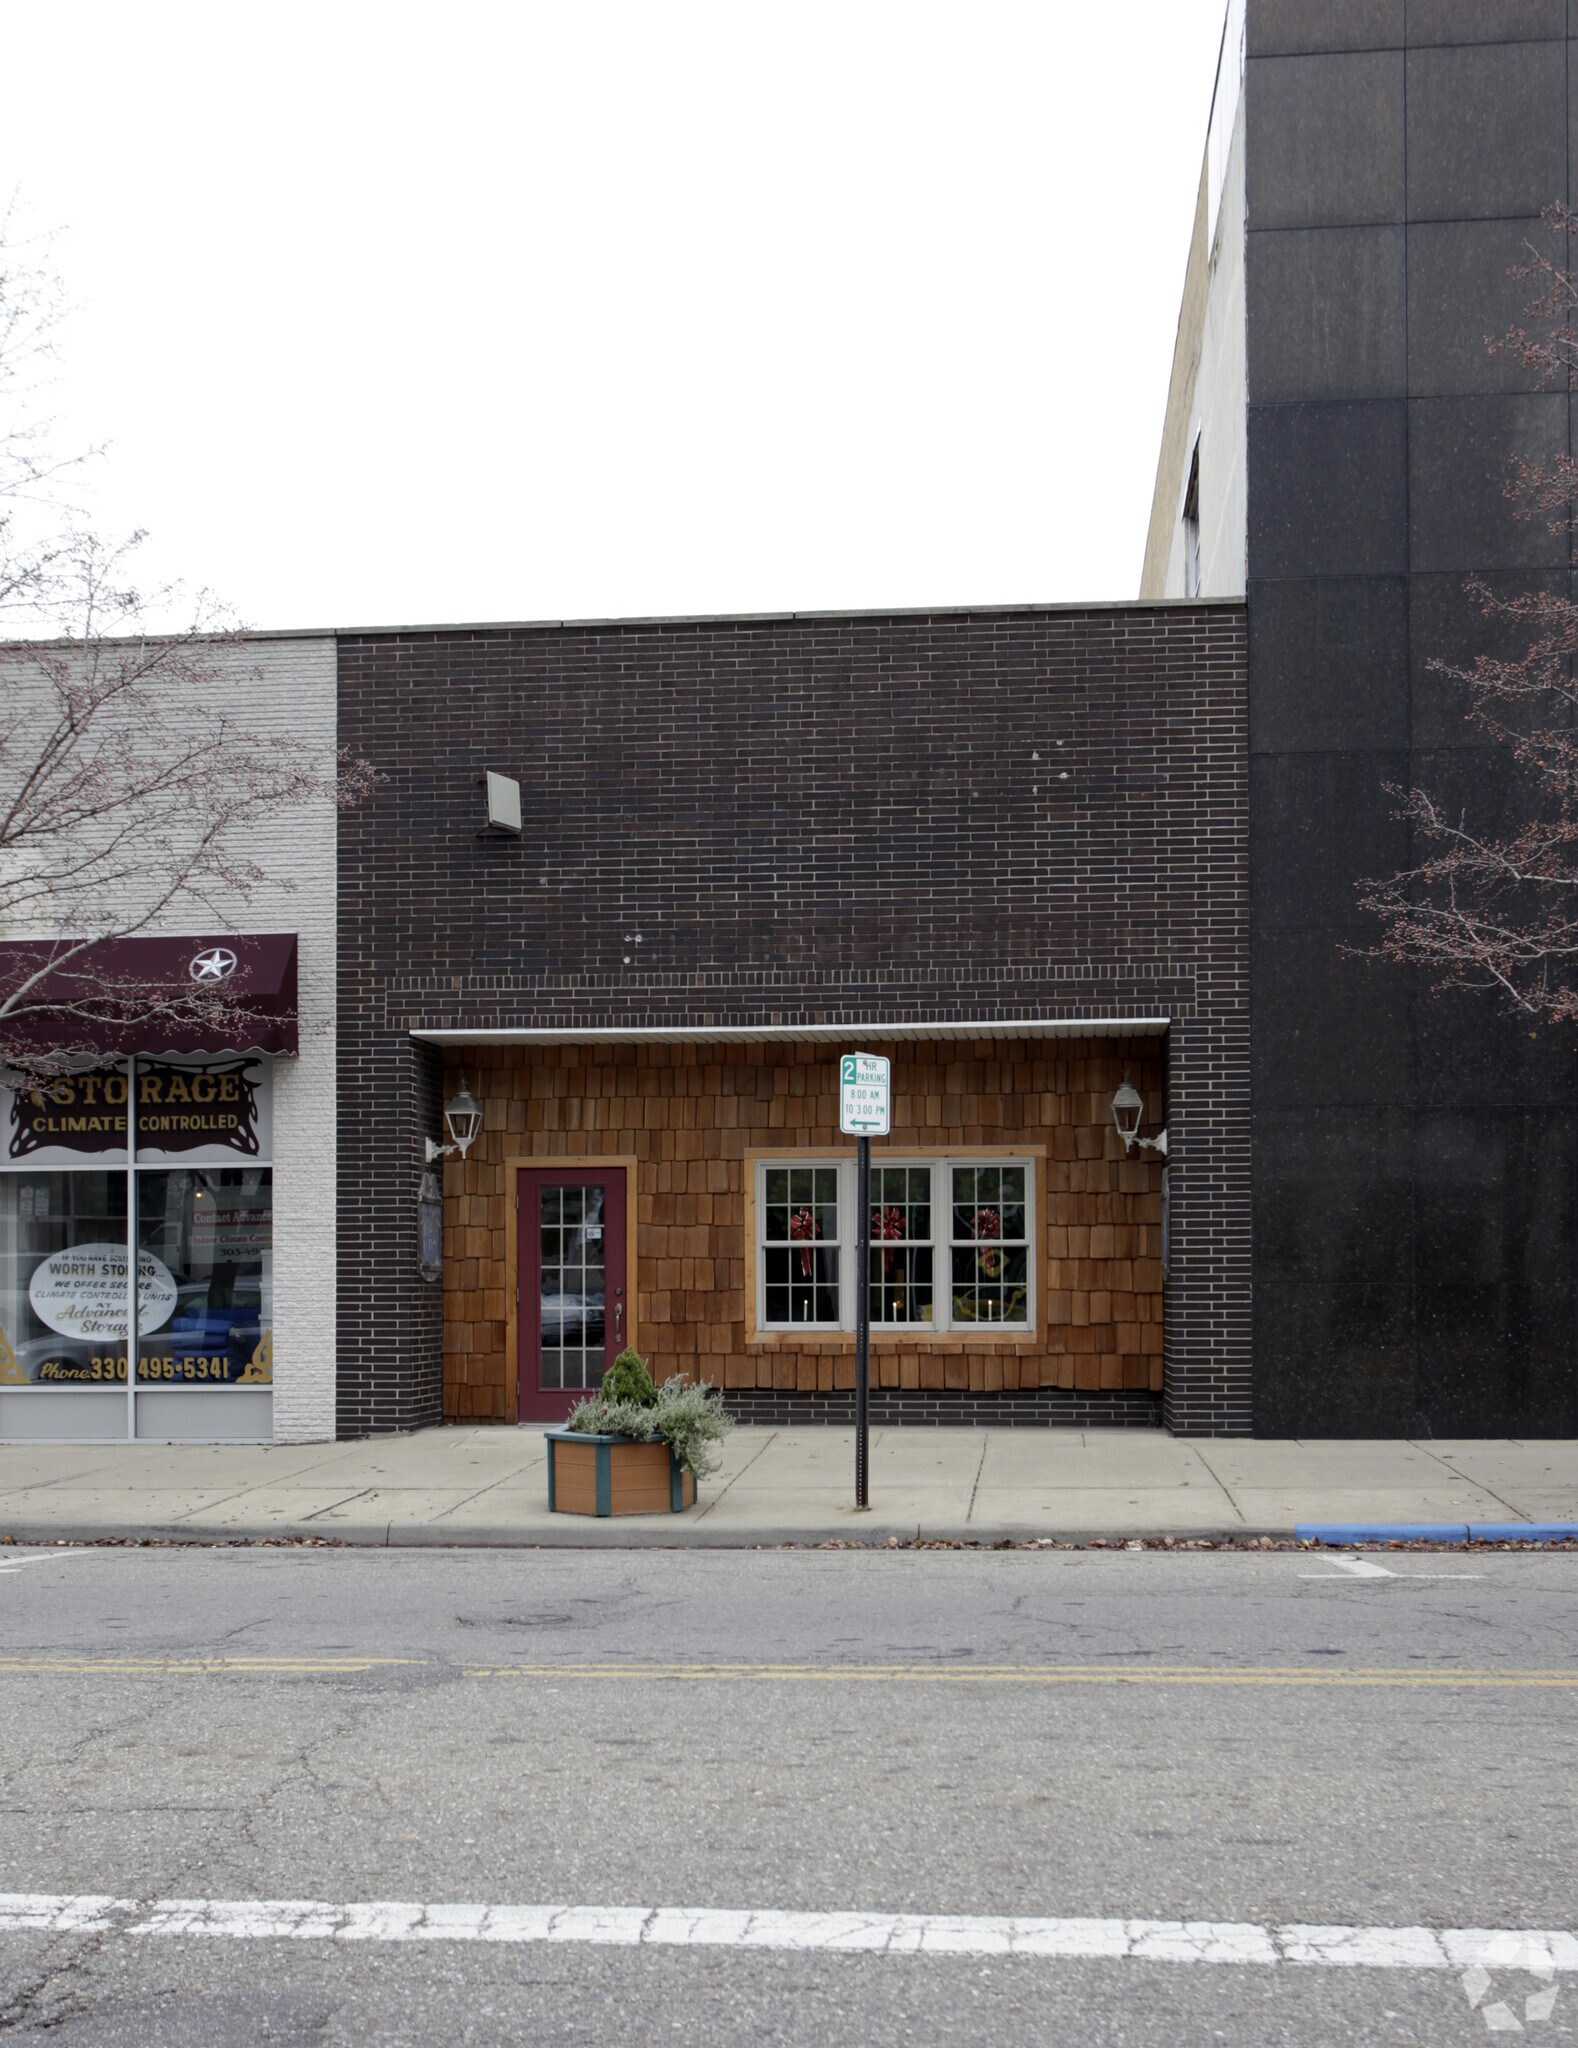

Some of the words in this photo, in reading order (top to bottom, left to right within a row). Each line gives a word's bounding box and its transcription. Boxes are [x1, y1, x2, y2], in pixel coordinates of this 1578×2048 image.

[844, 1061, 854, 1080] 2
[865, 1061, 877, 1071] HR
[857, 1072, 886, 1083] PARKING
[53, 1074, 240, 1105] STORAGE
[870, 1090, 880, 1100] AM
[845, 1104, 854, 1114] TO
[875, 1105, 885, 1115] PM
[32, 1116, 127, 1132] CLIMATE
[139, 1114, 238, 1131] CONTROLLED
[193, 1212, 231, 1224] Contact
[219, 1235, 248, 1244] Climate
[109, 1255, 153, 1263] SOMING
[49, 1263, 96, 1276] WORTH
[101, 1264, 165, 1278] STONG...
[54, 1281, 71, 1289] WE
[73, 1281, 108, 1289] OFFER
[109, 1281, 152, 1290] SECRE
[35, 1290, 77, 1299] CLIMATE
[79, 1291, 141, 1300] CONTROLL
[143, 1291, 174, 1301] UNITS
